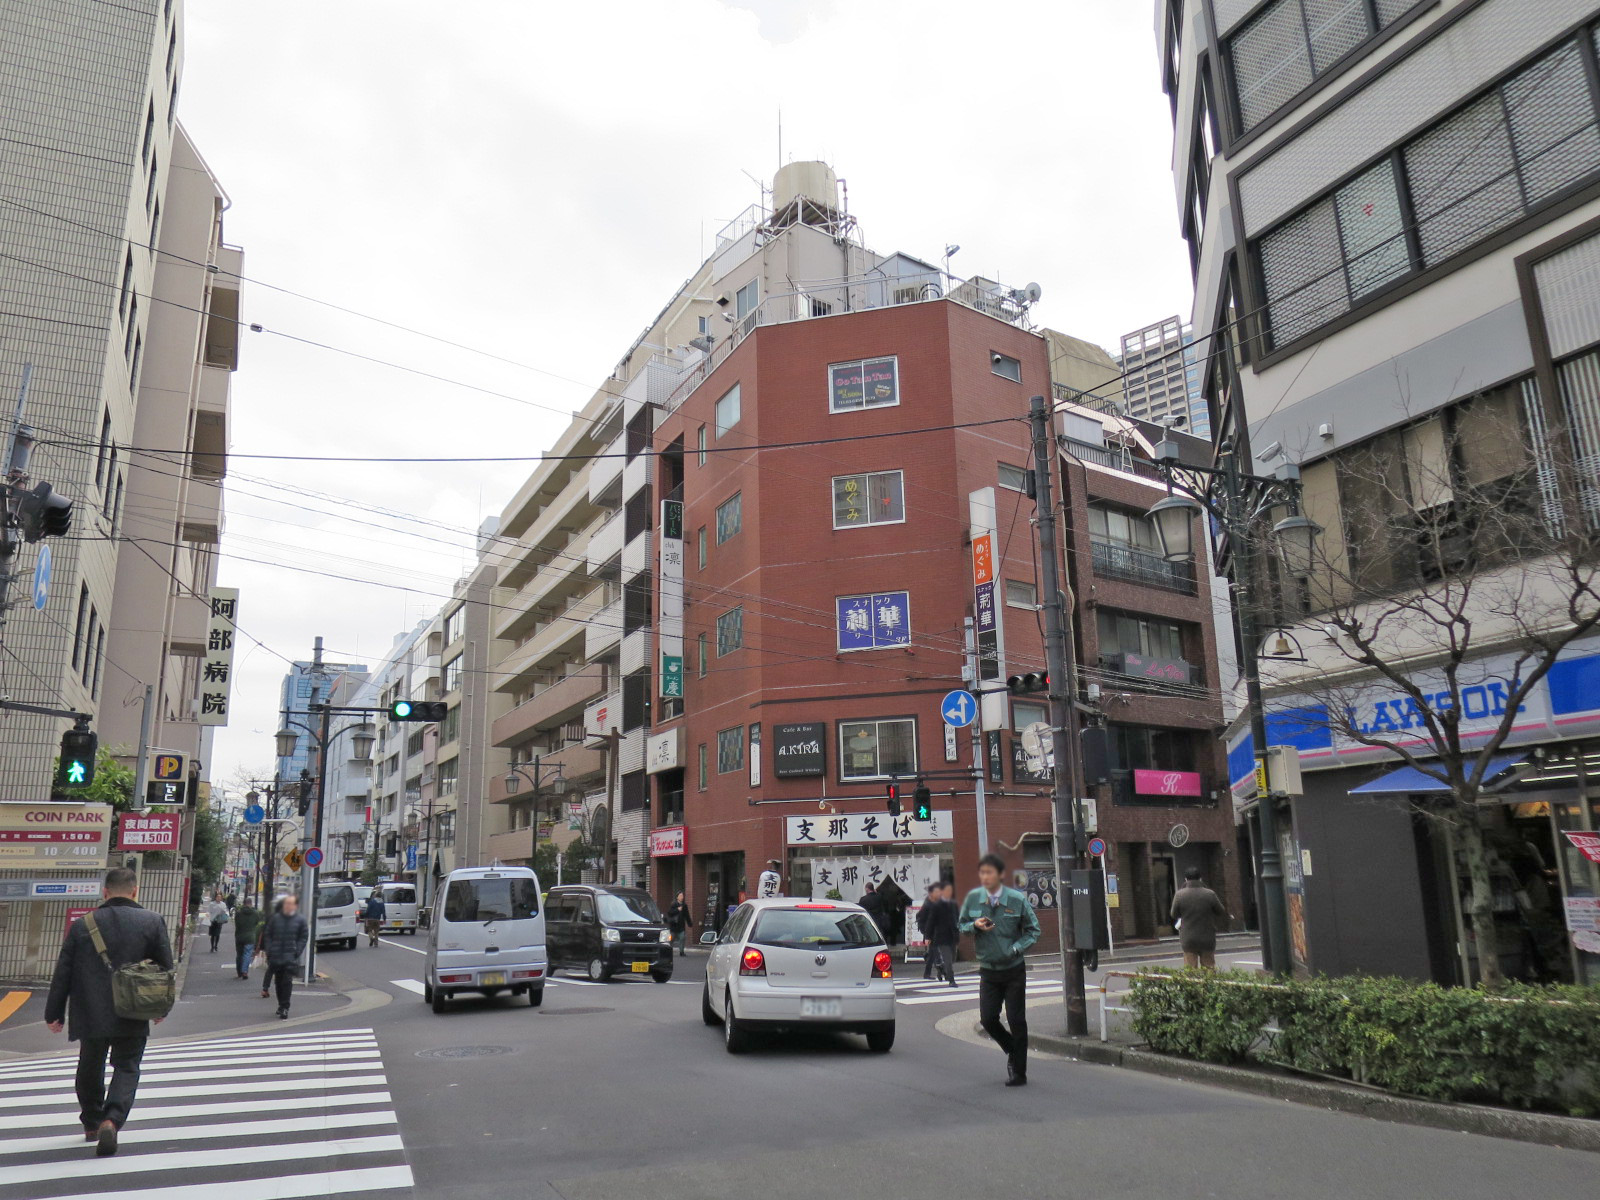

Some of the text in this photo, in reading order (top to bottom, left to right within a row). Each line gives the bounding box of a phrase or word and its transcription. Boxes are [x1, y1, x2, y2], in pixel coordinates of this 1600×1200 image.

[975, 543, 986, 579] めぐみ
[853, 597, 891, 608] スナック
[201, 597, 236, 715] 阿部病院
[666, 681, 680, 696] 慶
[25, 811, 104, 823] COIN PARK
[125, 819, 173, 830] 夜間最大
[795, 814, 915, 841] 支那そば
[816, 864, 912, 886] 支那そば
[762, 874, 778, 899] 支那そ
